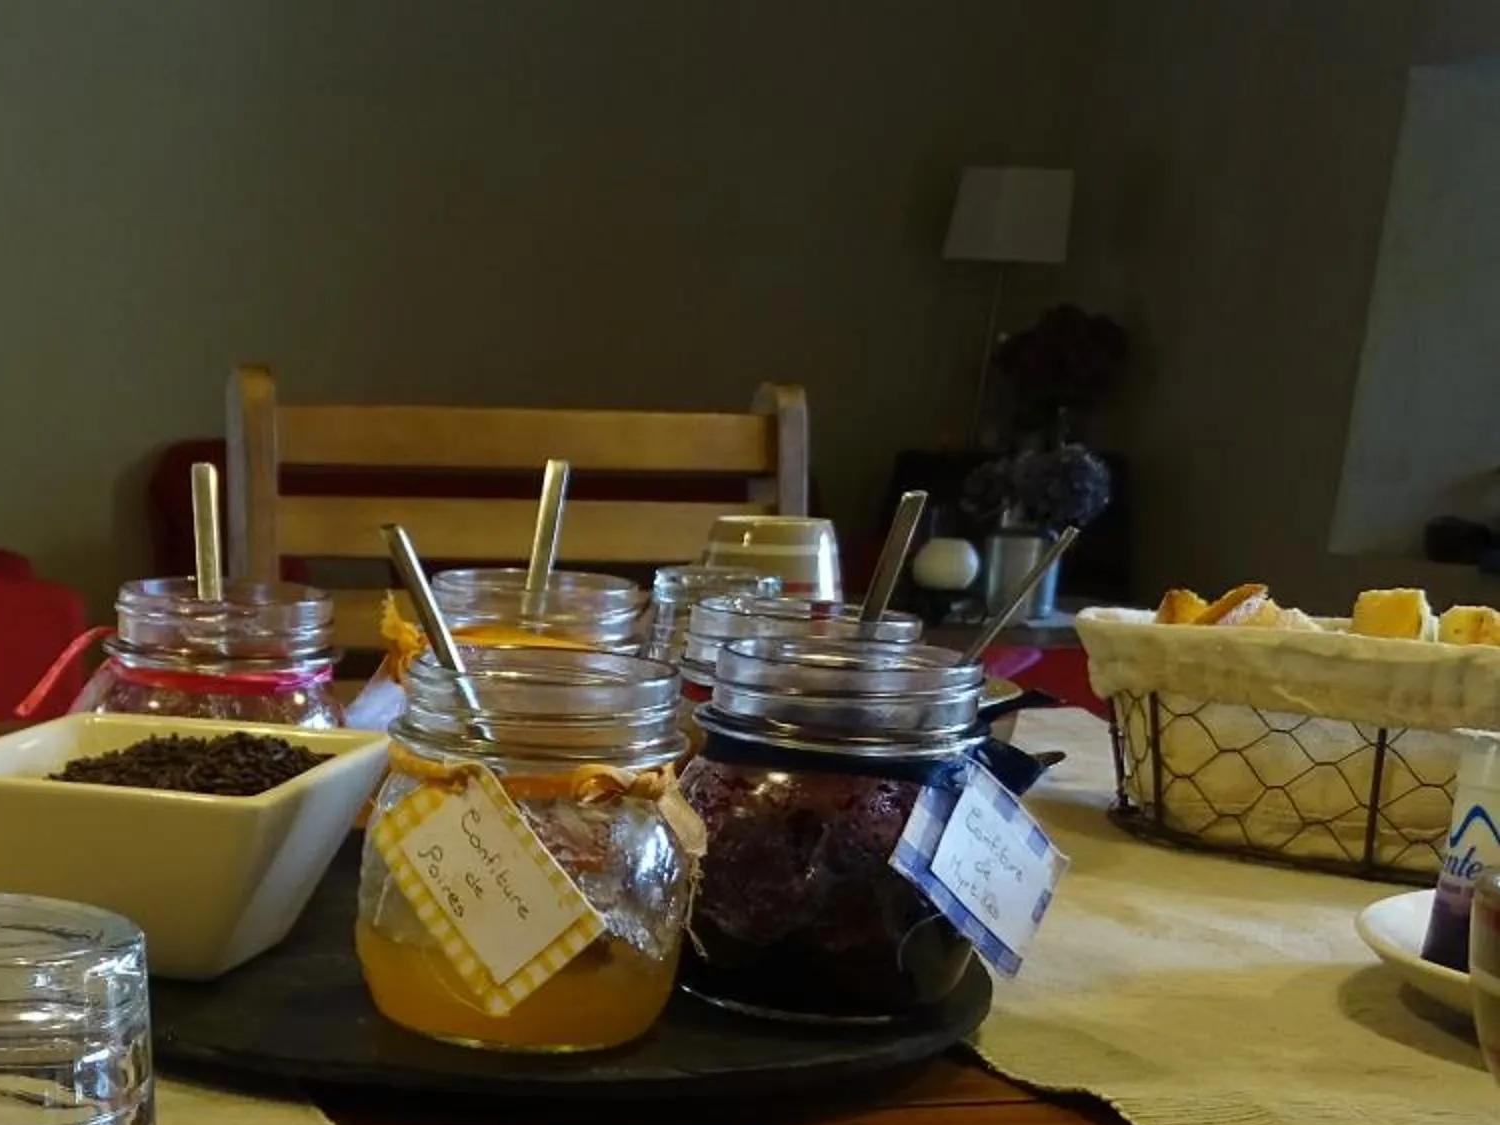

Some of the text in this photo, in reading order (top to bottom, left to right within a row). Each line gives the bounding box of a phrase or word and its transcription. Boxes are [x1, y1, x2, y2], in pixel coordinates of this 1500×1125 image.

[417, 845, 465, 919] Poires
[460, 808, 531, 921] Confiture
[465, 871, 485, 900] de
